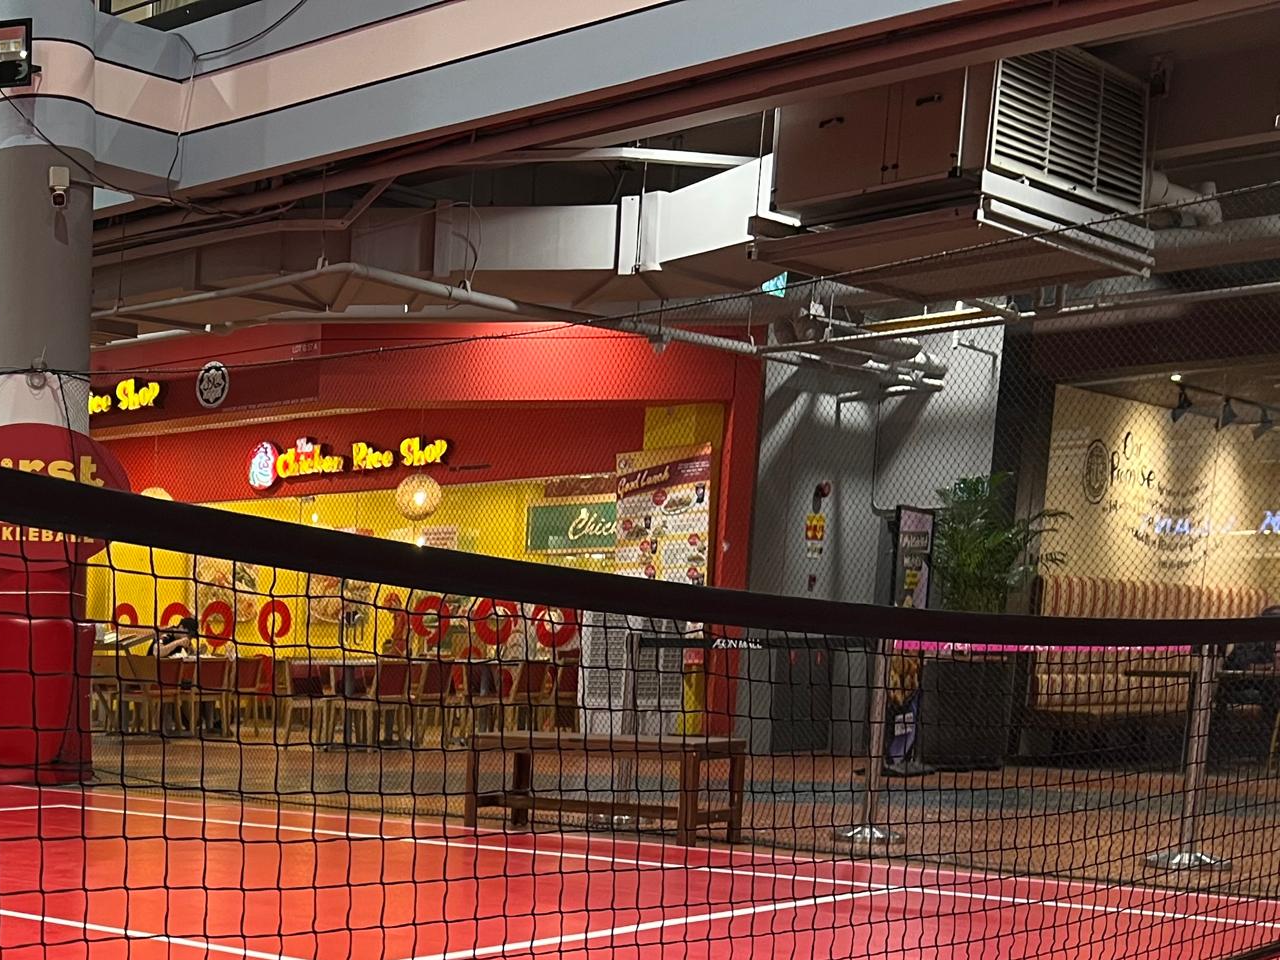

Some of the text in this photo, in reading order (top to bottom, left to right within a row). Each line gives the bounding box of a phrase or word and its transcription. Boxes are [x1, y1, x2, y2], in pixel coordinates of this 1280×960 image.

[88, 391, 112, 415] ice
[275, 444, 344, 479] Chicken
[351, 441, 394, 471] Rice
